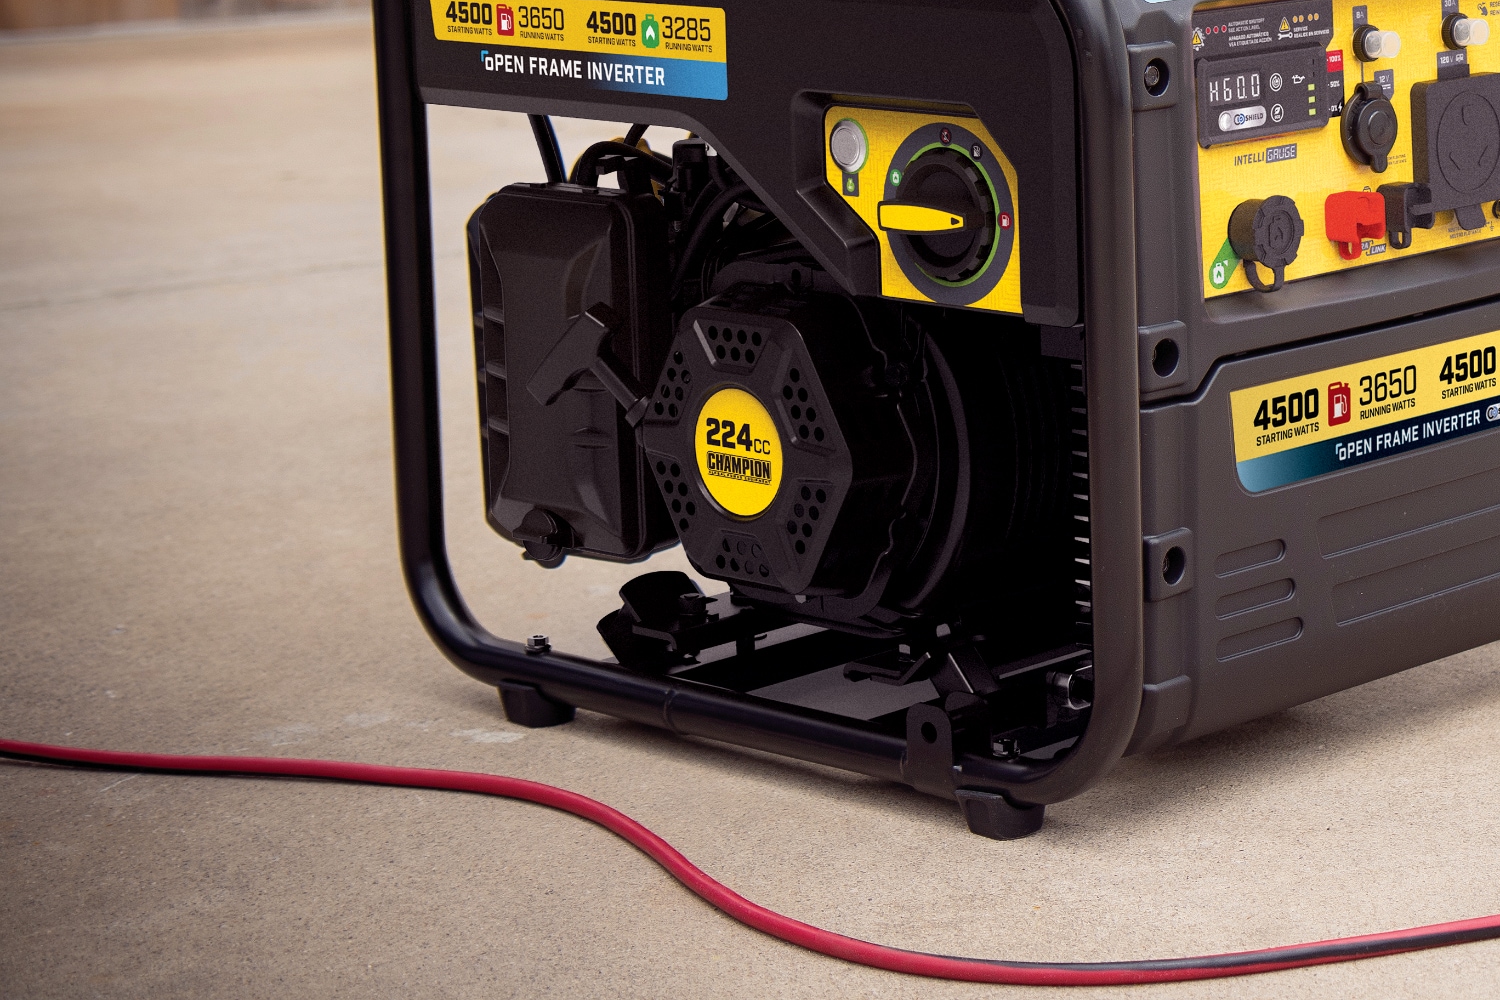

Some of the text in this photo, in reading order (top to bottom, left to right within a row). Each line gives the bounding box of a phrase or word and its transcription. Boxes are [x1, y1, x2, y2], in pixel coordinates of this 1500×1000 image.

[445, 0, 493, 25] 4500
[518, 5, 565, 31] 3650
[586, 10, 637, 36] 4500
[447, 25, 492, 36] STARTING WATTS
[519, 30, 564, 41] RUNNING WATTS
[587, 36, 636, 47] STARTING WATTS
[661, 15, 711, 42] 3285
[665, 42, 713, 53] RUNNING WATTS
[529, 56, 583, 79] FRAME
[587, 61, 666, 86] INVERTER
[1439, 345, 1496, 385] 4500
[1359, 364, 1417, 406] 3650
[1441, 377, 1497, 400] STARTING WATTS
[1253, 387, 1319, 431] 4500
[1360, 397, 1416, 420] RUNNING WATTS
[1256, 421, 1320, 447] STARTING WATTS
[1376, 425, 1419, 451] FRAME
[1422, 409, 1481, 439] INVERTER
[707, 452, 770, 479] CHAMPION
